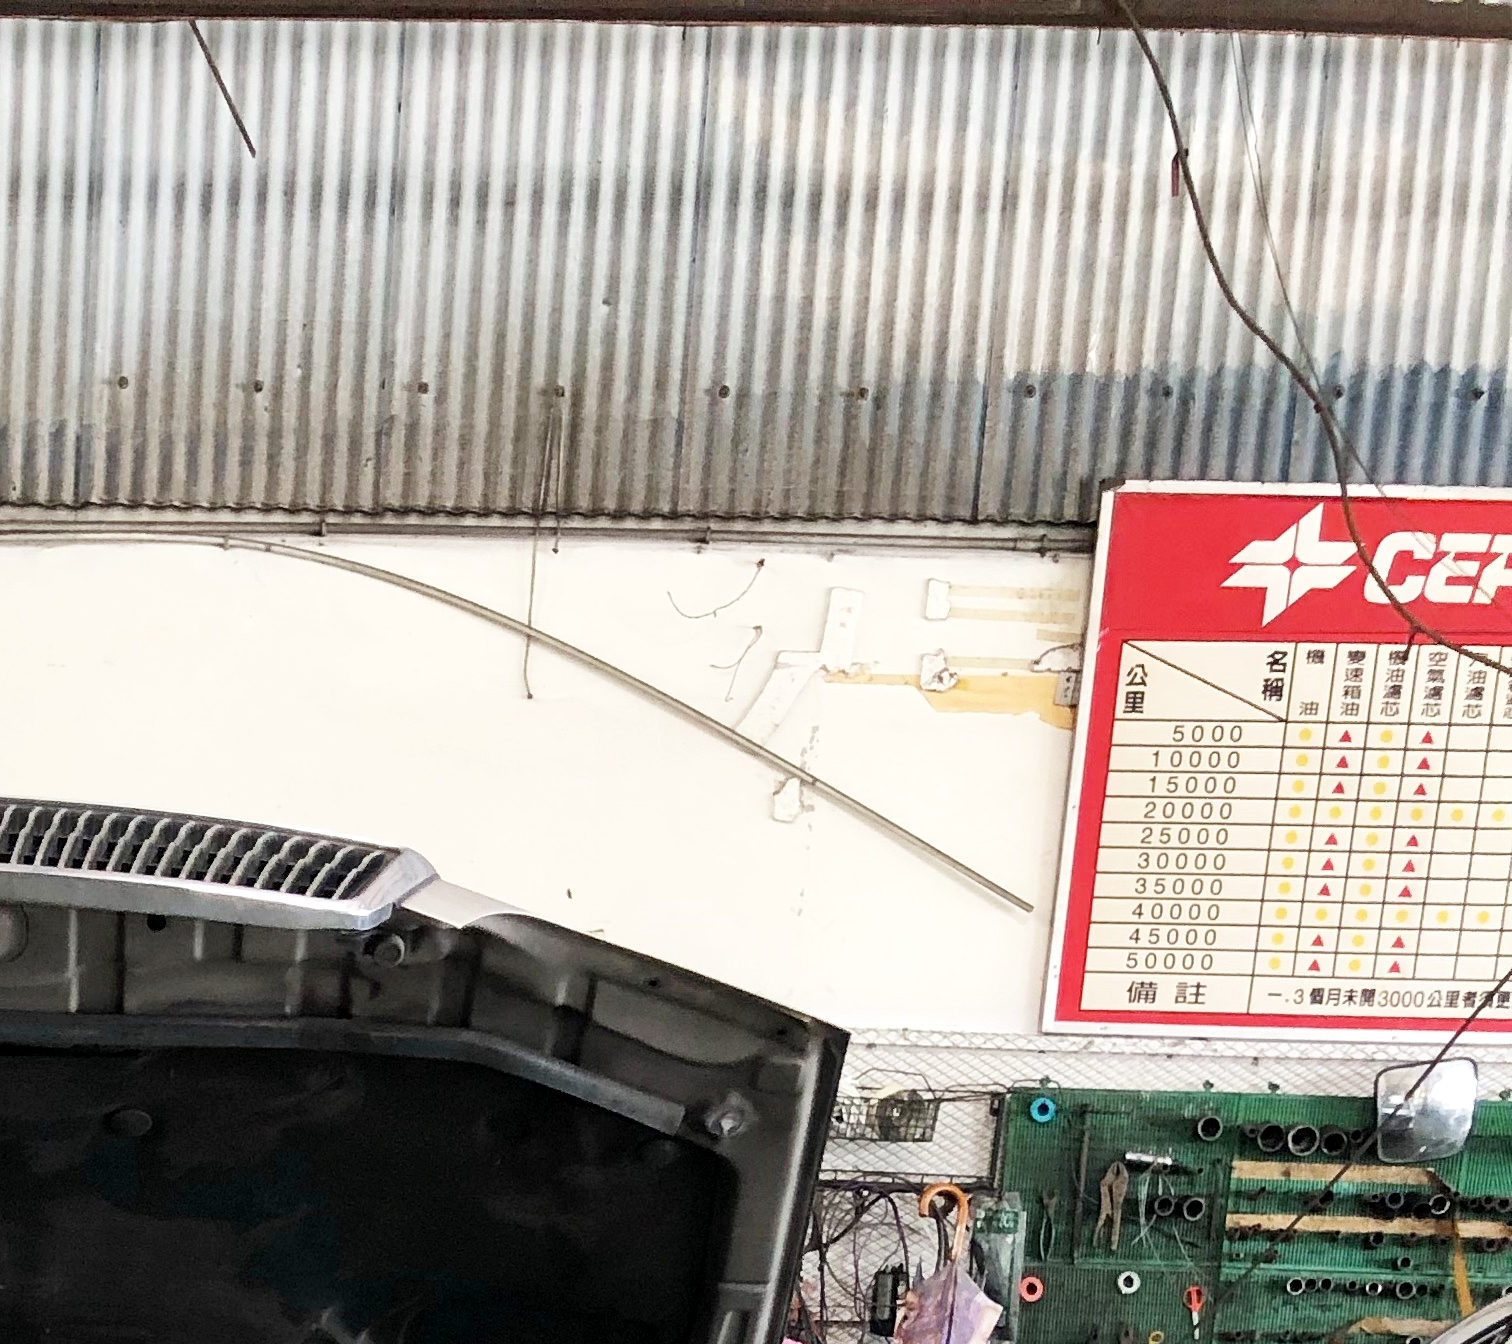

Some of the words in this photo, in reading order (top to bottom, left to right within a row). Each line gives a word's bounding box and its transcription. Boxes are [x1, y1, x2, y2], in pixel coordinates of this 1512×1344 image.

[1261, 650, 1288, 702] 名稱
[1340, 649, 1366, 717] 變速箱油
[1122, 663, 1149, 714] 公里
[1172, 725, 1243, 742] 5000
[1152, 750, 1240, 768] 10000
[1149, 776, 1236, 794] 15000
[1143, 802, 1232, 820] 20000
[1140, 827, 1228, 845] 25000
[1137, 852, 1226, 871] 30000
[1134, 878, 1223, 896] 35000
[1132, 903, 1220, 921] 40000
[1129, 928, 1216, 946] 45000
[1126, 953, 1213, 971] 50000
[1126, 980, 1207, 1005] 備註
